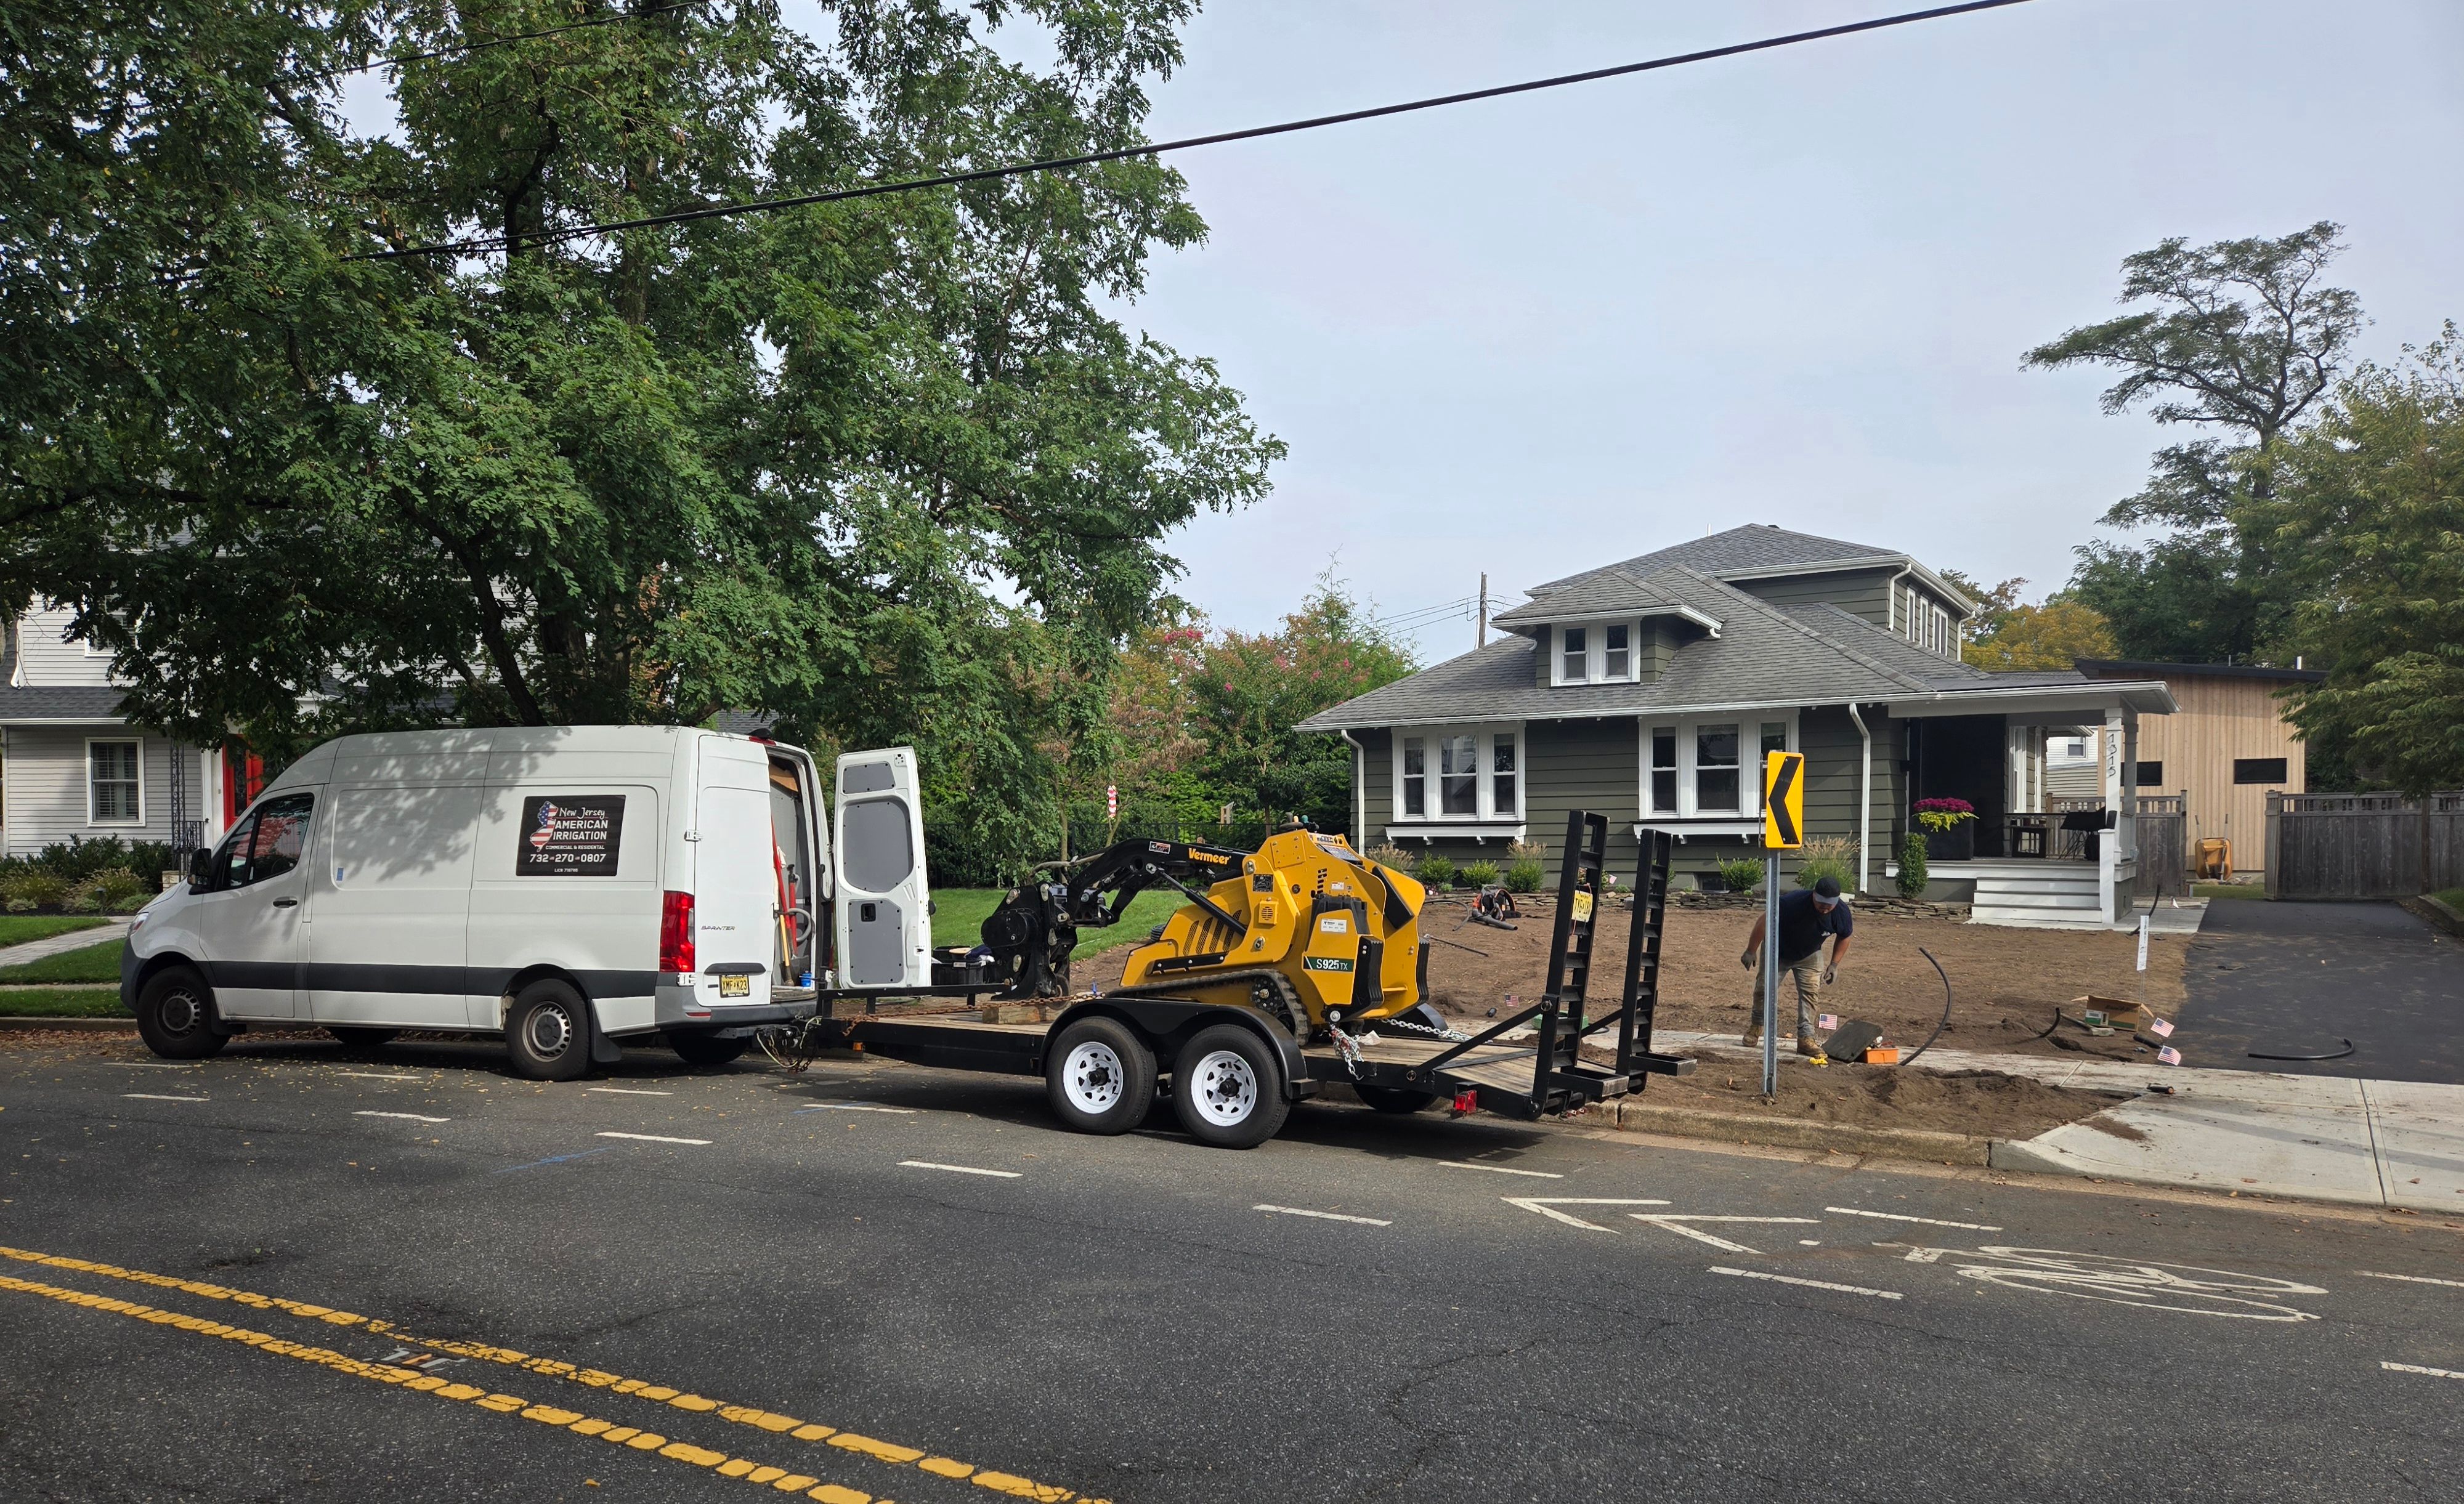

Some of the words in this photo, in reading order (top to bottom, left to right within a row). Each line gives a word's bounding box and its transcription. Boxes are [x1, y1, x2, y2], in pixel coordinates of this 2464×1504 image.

[2107, 734, 2117, 777] 1315
[559, 807, 577, 817] New
[577, 807, 605, 820] Jersey
[555, 820, 609, 829] AMERICAN
[553, 831, 607, 840] IRRIGATION
[530, 854, 606, 862] 732-270-0807
[1188, 847, 1230, 865] Vermeer
